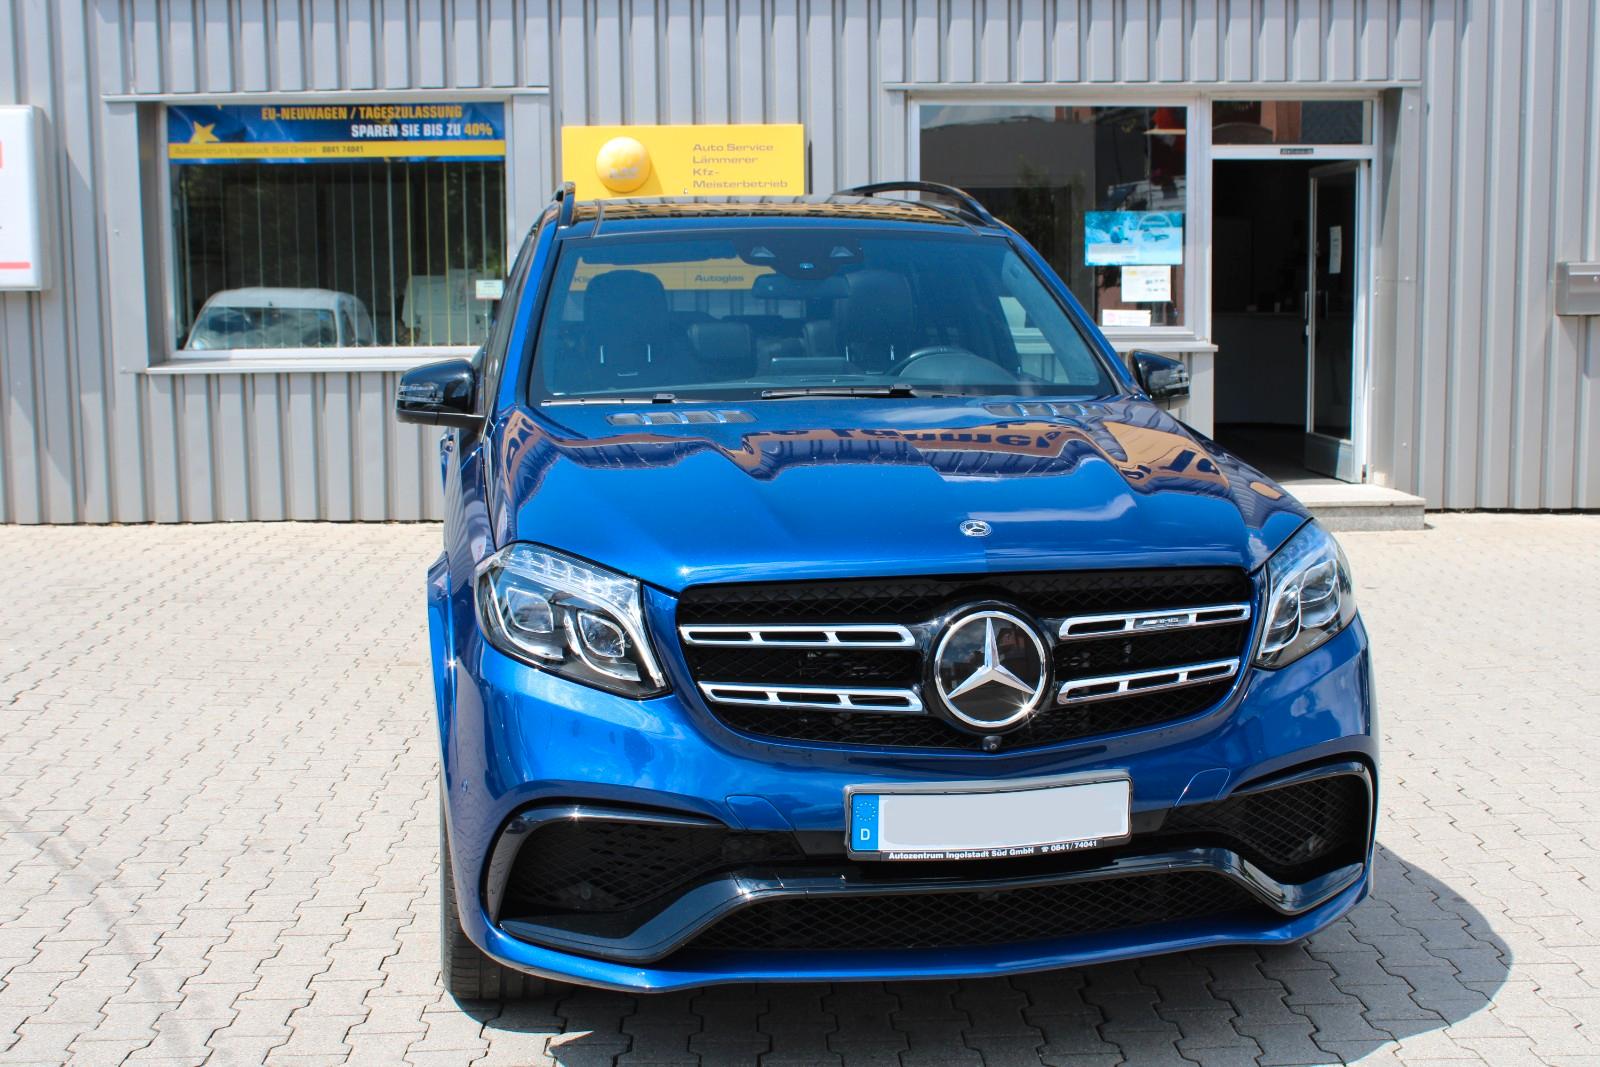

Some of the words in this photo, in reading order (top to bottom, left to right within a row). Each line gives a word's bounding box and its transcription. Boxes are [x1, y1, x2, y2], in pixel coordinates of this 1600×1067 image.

[261, 107, 348, 121] EU-NEUWAGEN
[358, 106, 462, 120] TAGESZULASSUNG
[351, 124, 398, 138] SPAREN
[401, 124, 420, 137] SIE
[423, 123, 443, 137] BIS
[446, 123, 461, 136] ZU
[464, 122, 493, 136] 40%
[693, 143, 724, 152] Auto
[726, 143, 774, 152] Service
[693, 155, 759, 164] Lämmerer
[693, 167, 720, 176] Kfz-
[693, 180, 788, 189] Meisterbetrieb
[694, 273, 745, 284] Autoglas
[860, 828, 870, 841] D
[888, 851, 944, 860] Autozentrum
[945, 850, 990, 861] Ingolstadt
[991, 848, 1008, 858] Süd
[1009, 846, 1035, 856] GmbH
